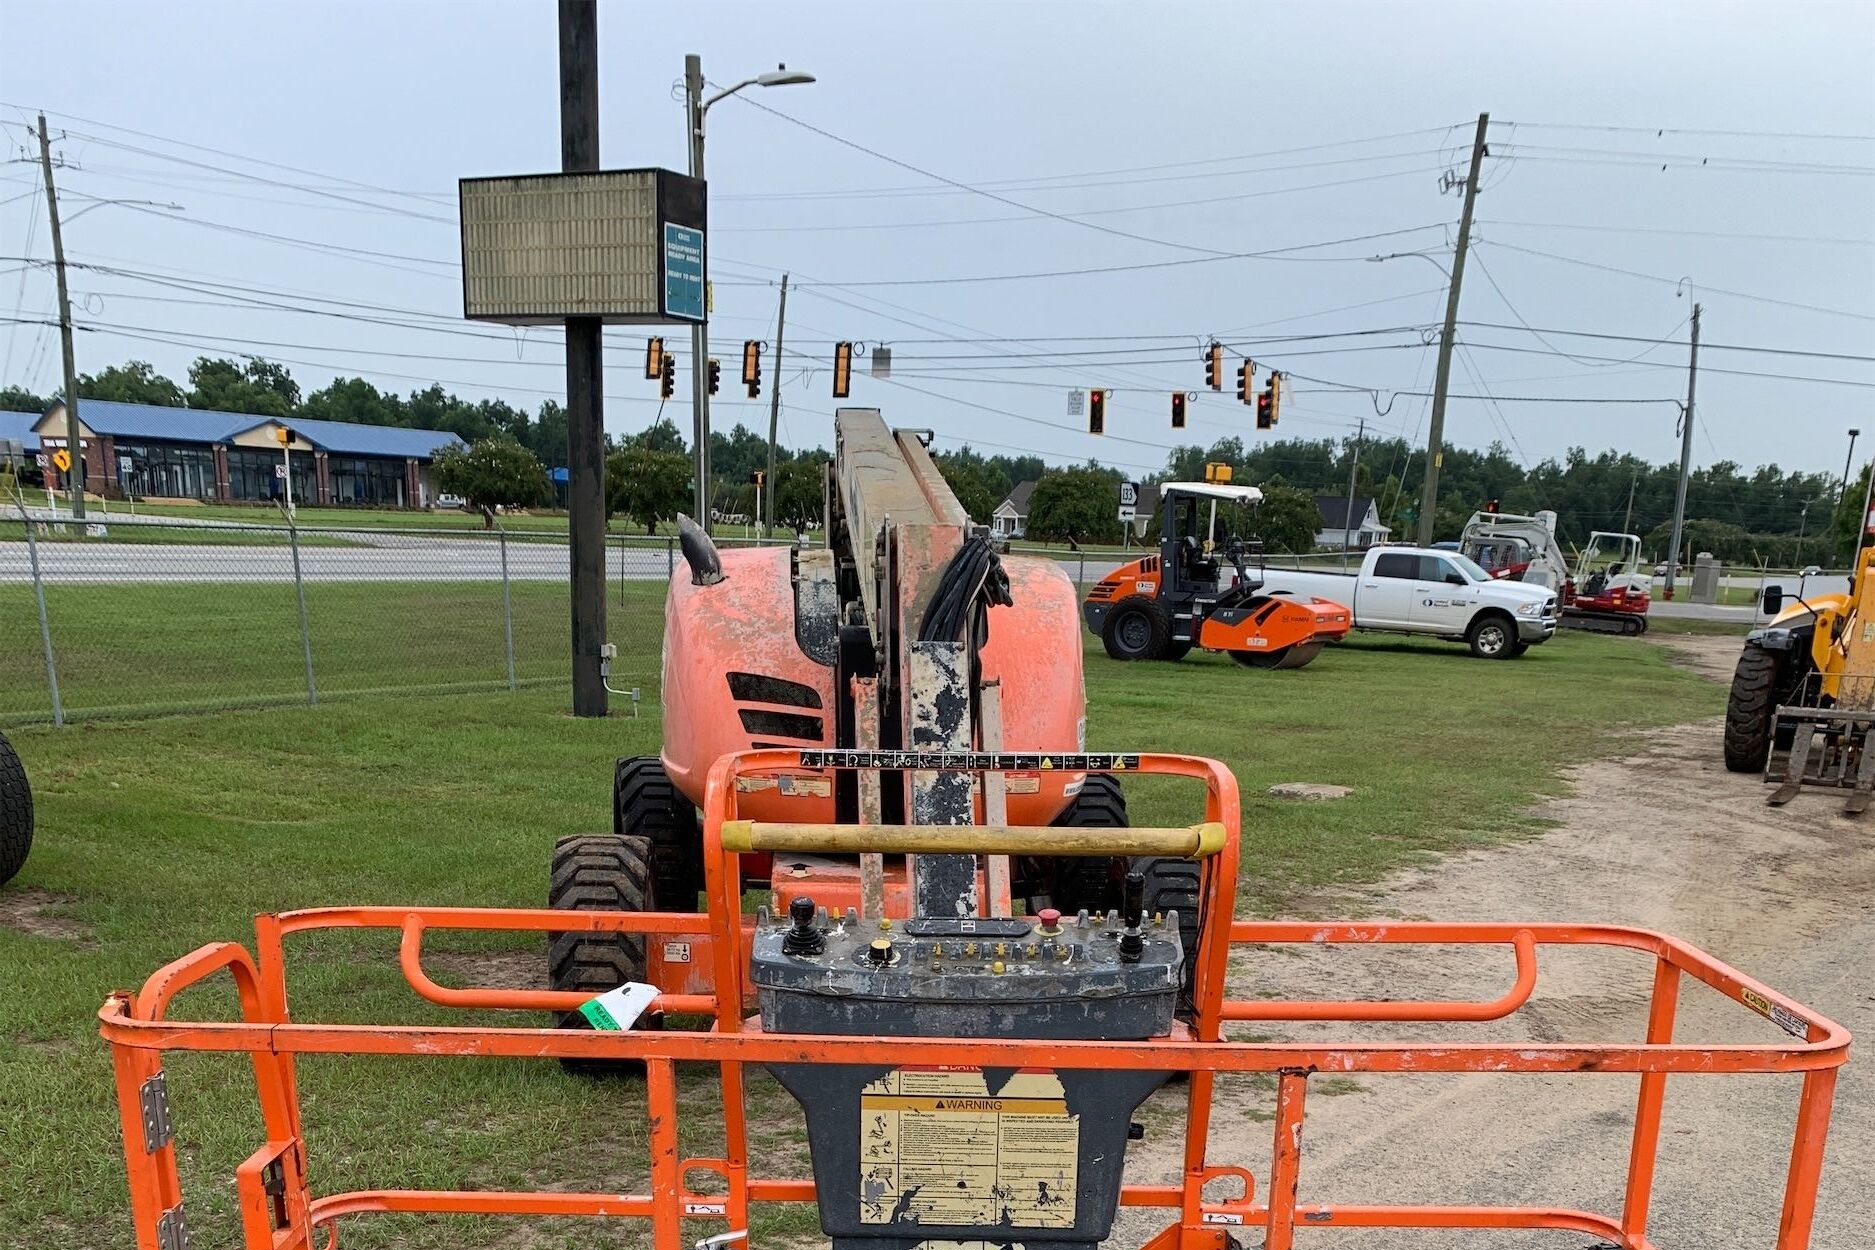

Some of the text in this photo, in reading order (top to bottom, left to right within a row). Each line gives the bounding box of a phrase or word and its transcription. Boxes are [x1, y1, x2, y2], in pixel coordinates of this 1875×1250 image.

[667, 242, 700, 256] EQUIPMENT
[667, 250, 700, 264] READY AREA
[1122, 488, 1133, 501] 133
[594, 1005, 615, 1027] READY
[947, 1100, 1003, 1111] WARNING
